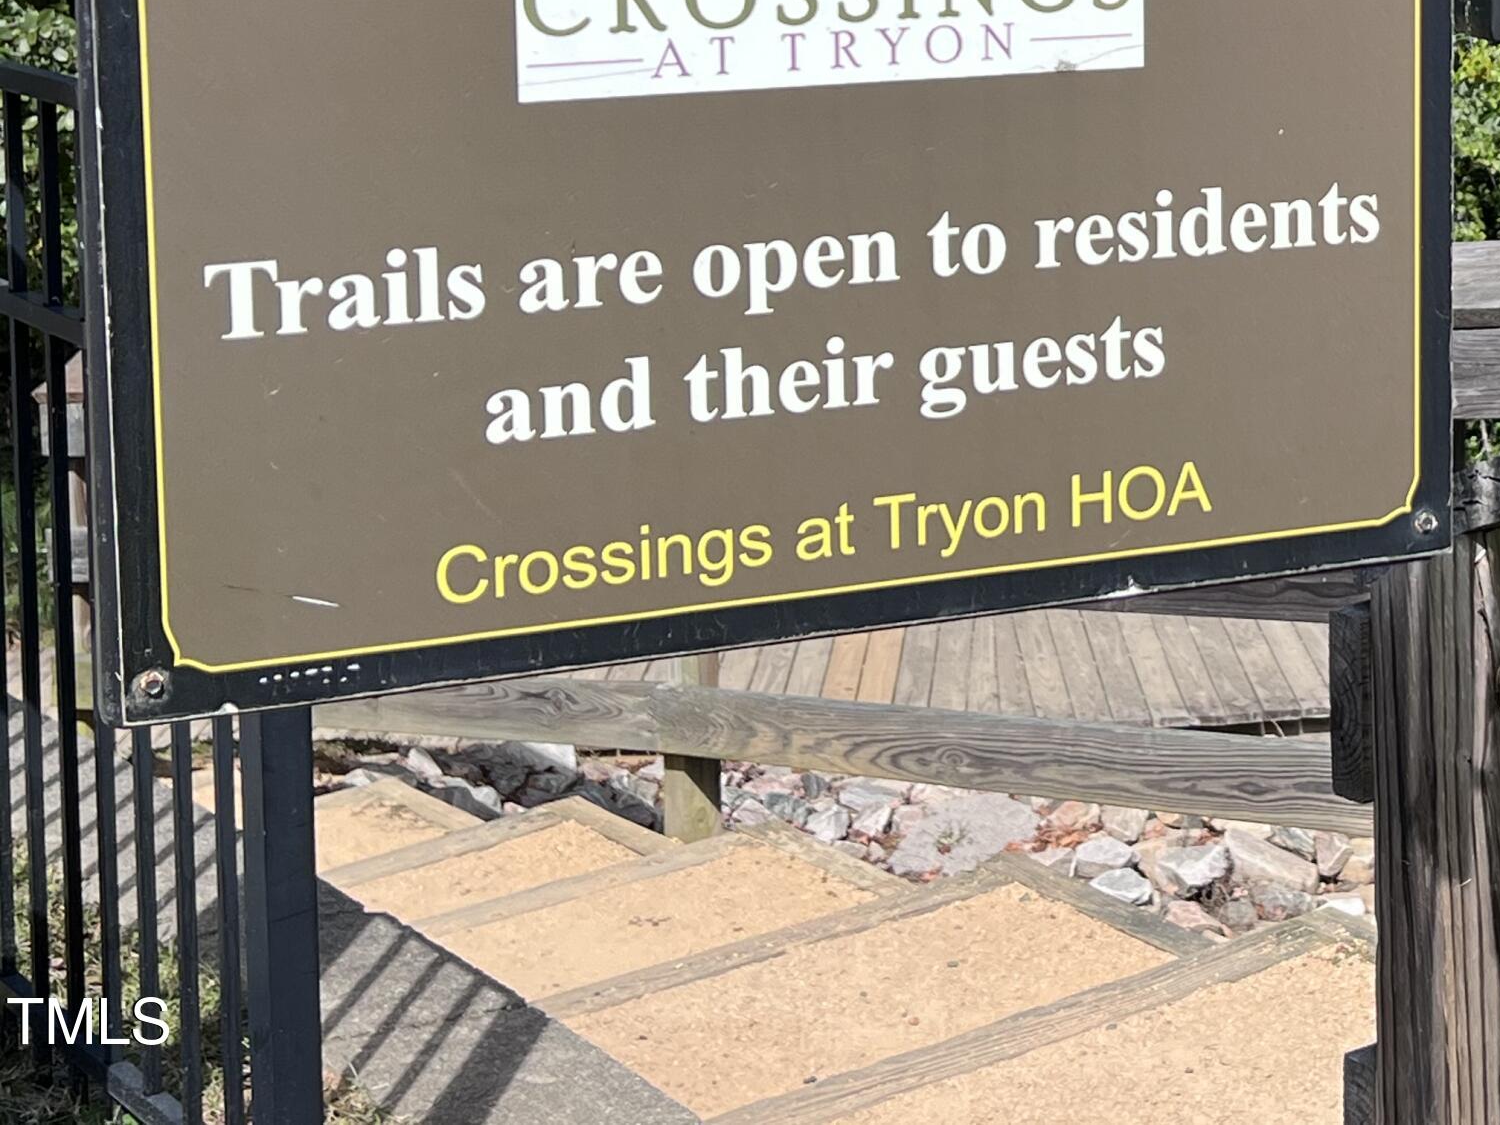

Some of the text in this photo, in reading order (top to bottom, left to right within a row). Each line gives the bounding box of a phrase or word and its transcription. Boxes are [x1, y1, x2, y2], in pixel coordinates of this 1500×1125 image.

[651, 22, 1016, 79] AT TRYON
[203, 182, 1380, 340] Trails are open to residents
[485, 315, 1165, 444] and their guests
[436, 460, 1213, 604] Crossings at Tryon HOA
